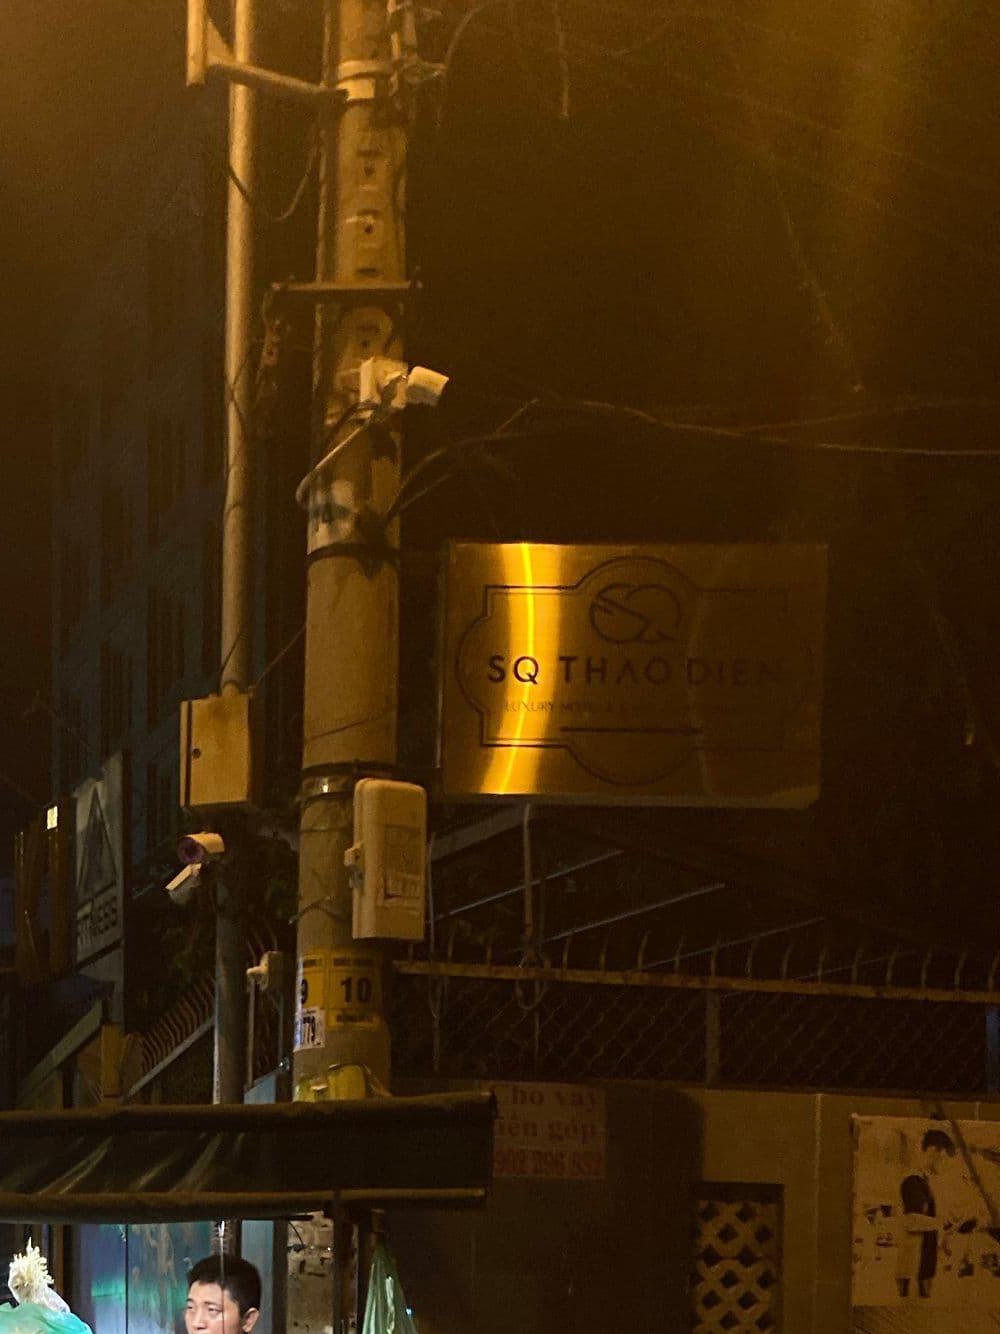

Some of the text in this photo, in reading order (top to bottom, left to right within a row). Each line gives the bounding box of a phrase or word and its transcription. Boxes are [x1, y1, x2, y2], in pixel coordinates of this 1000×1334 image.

[488, 655, 540, 684] SQ
[559, 655, 672, 685] THAO
[341, 976, 372, 1004] 10
